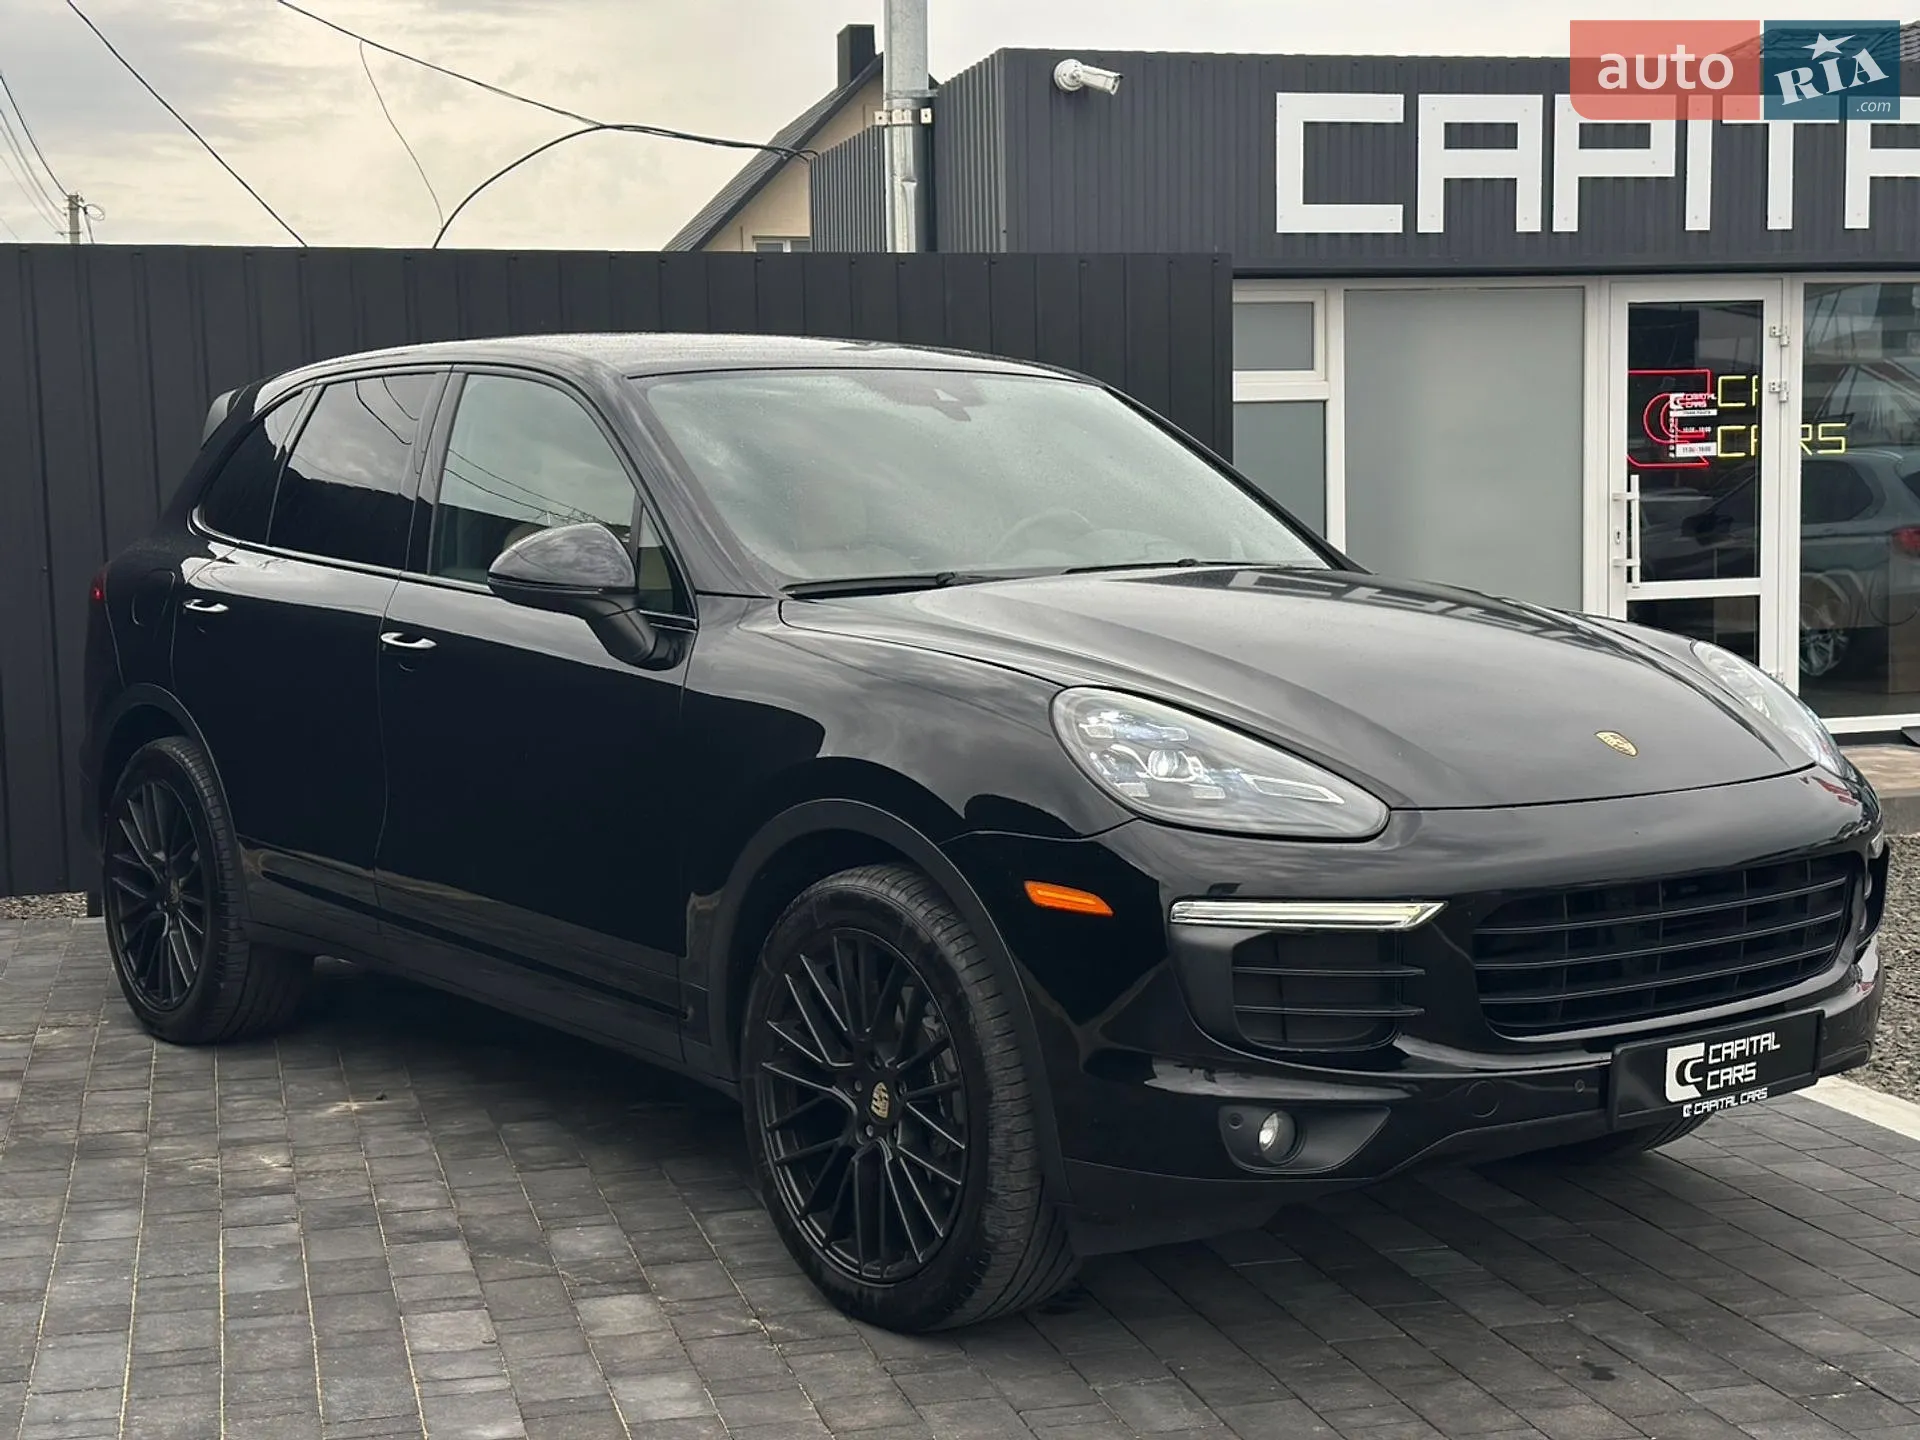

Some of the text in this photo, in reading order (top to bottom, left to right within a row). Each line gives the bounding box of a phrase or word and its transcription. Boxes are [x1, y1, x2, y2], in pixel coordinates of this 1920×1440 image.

[1708, 1031, 1781, 1064] CAPITAL
[1706, 1062, 1757, 1091] CARS
[1694, 1087, 1768, 1115] CAPITAL CARS
